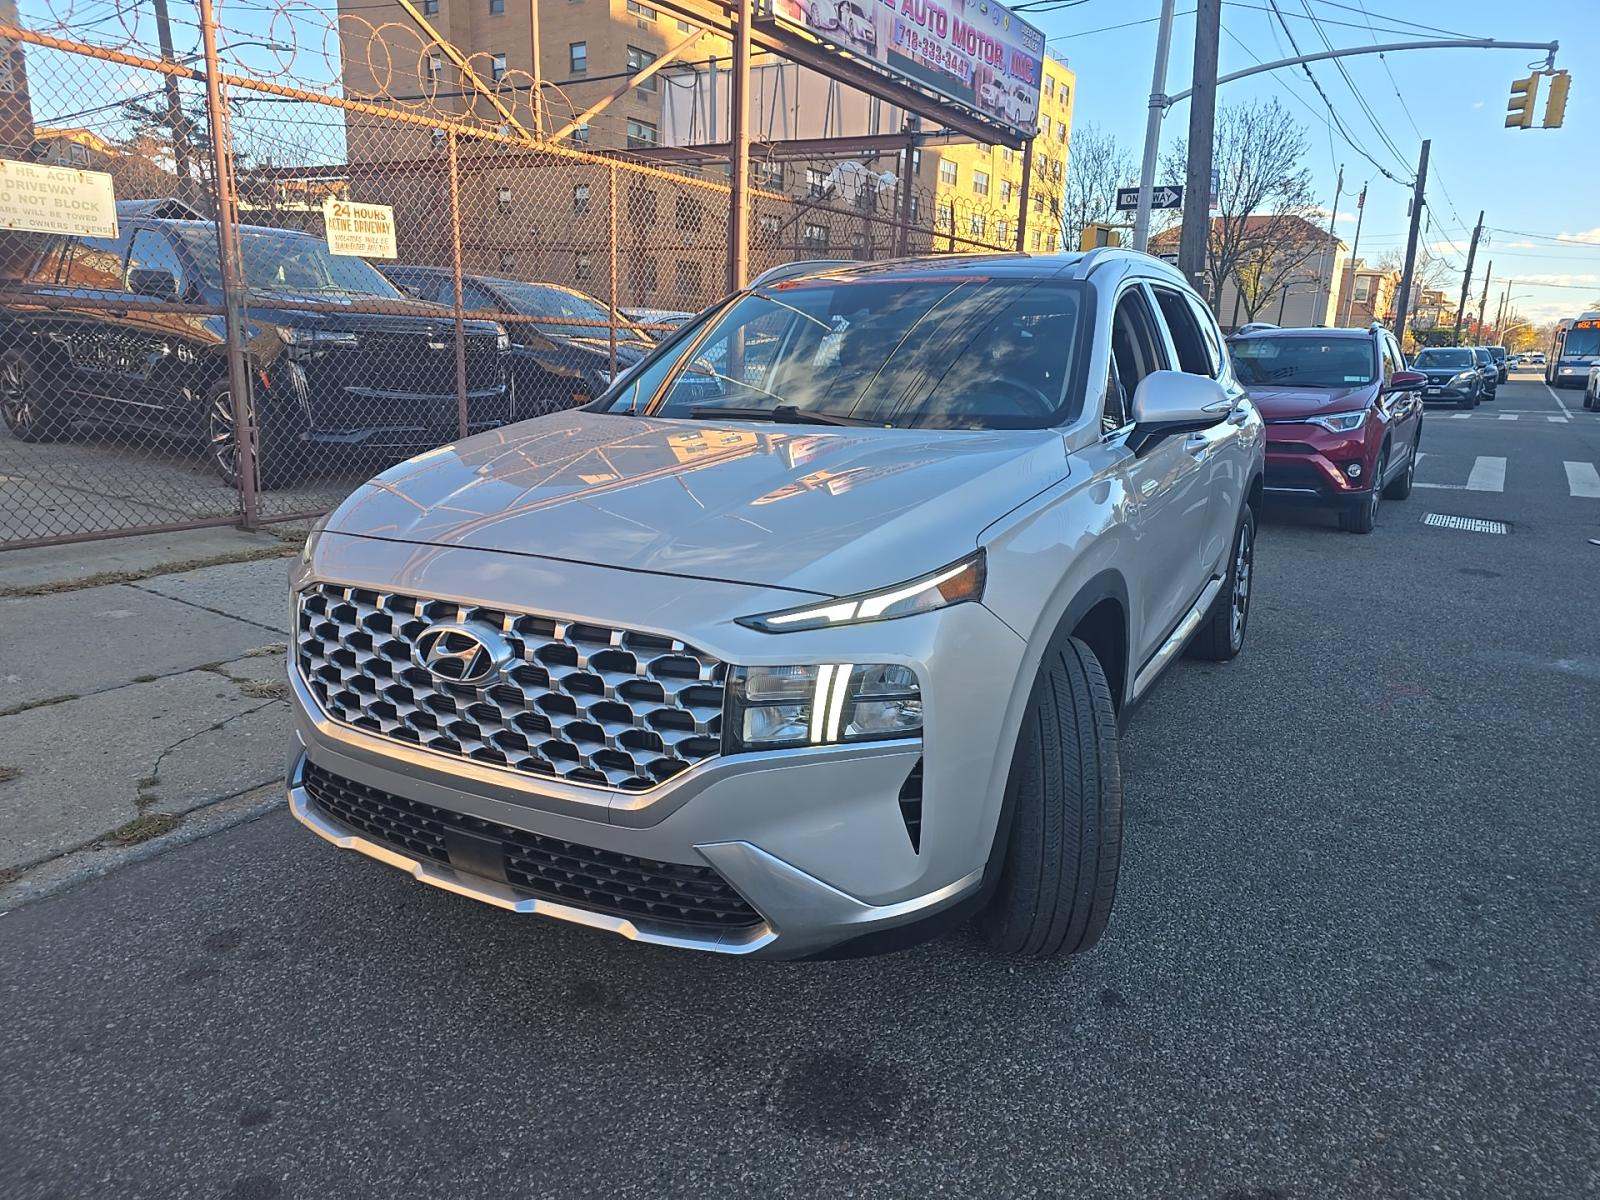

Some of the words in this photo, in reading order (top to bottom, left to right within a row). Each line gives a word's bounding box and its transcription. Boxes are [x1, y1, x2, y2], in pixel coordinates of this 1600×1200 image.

[901, 0, 948, 38] AUTO
[47, 170, 95, 185] ACTIVE
[5, 179, 76, 196] DRIVEWAY
[0, 192, 11, 202] O
[18, 194, 47, 206] NOT
[54, 198, 101, 212] BLOCK
[1125, 194, 1139, 204] ON
[1152, 193, 1173, 203] WAY
[22, 208, 46, 217] WILL
[66, 212, 98, 222] TOWED
[333, 203, 351, 218] 24
[353, 207, 386, 220] HOURS
[29, 219, 69, 230] OWNERS
[328, 216, 353, 232] ACTIVE
[354, 219, 391, 235] DRIVEWAY
